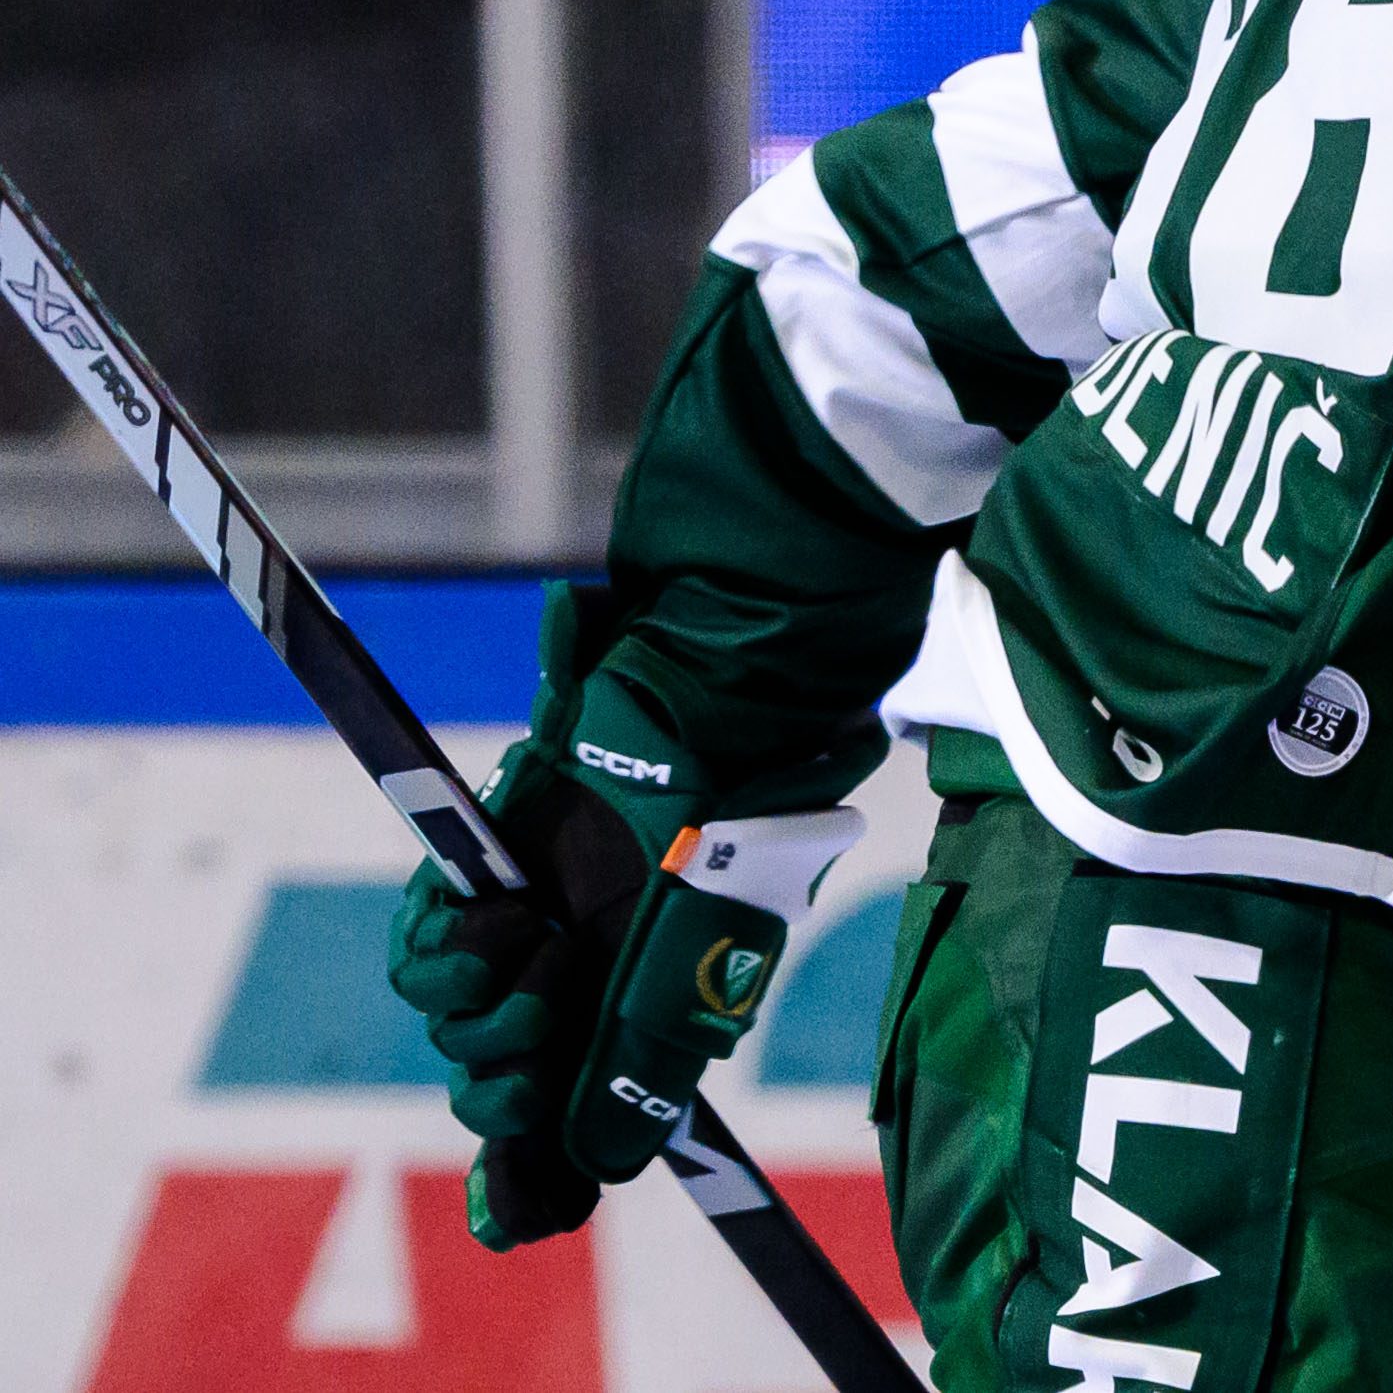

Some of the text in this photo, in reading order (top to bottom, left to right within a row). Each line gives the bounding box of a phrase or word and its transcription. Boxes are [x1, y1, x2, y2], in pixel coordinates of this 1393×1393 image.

[87, 354, 152, 427] PRO
[1068, 326, 1344, 594] DENIČ
[1291, 707, 1340, 742] 125
[576, 741, 672, 785] CCM
